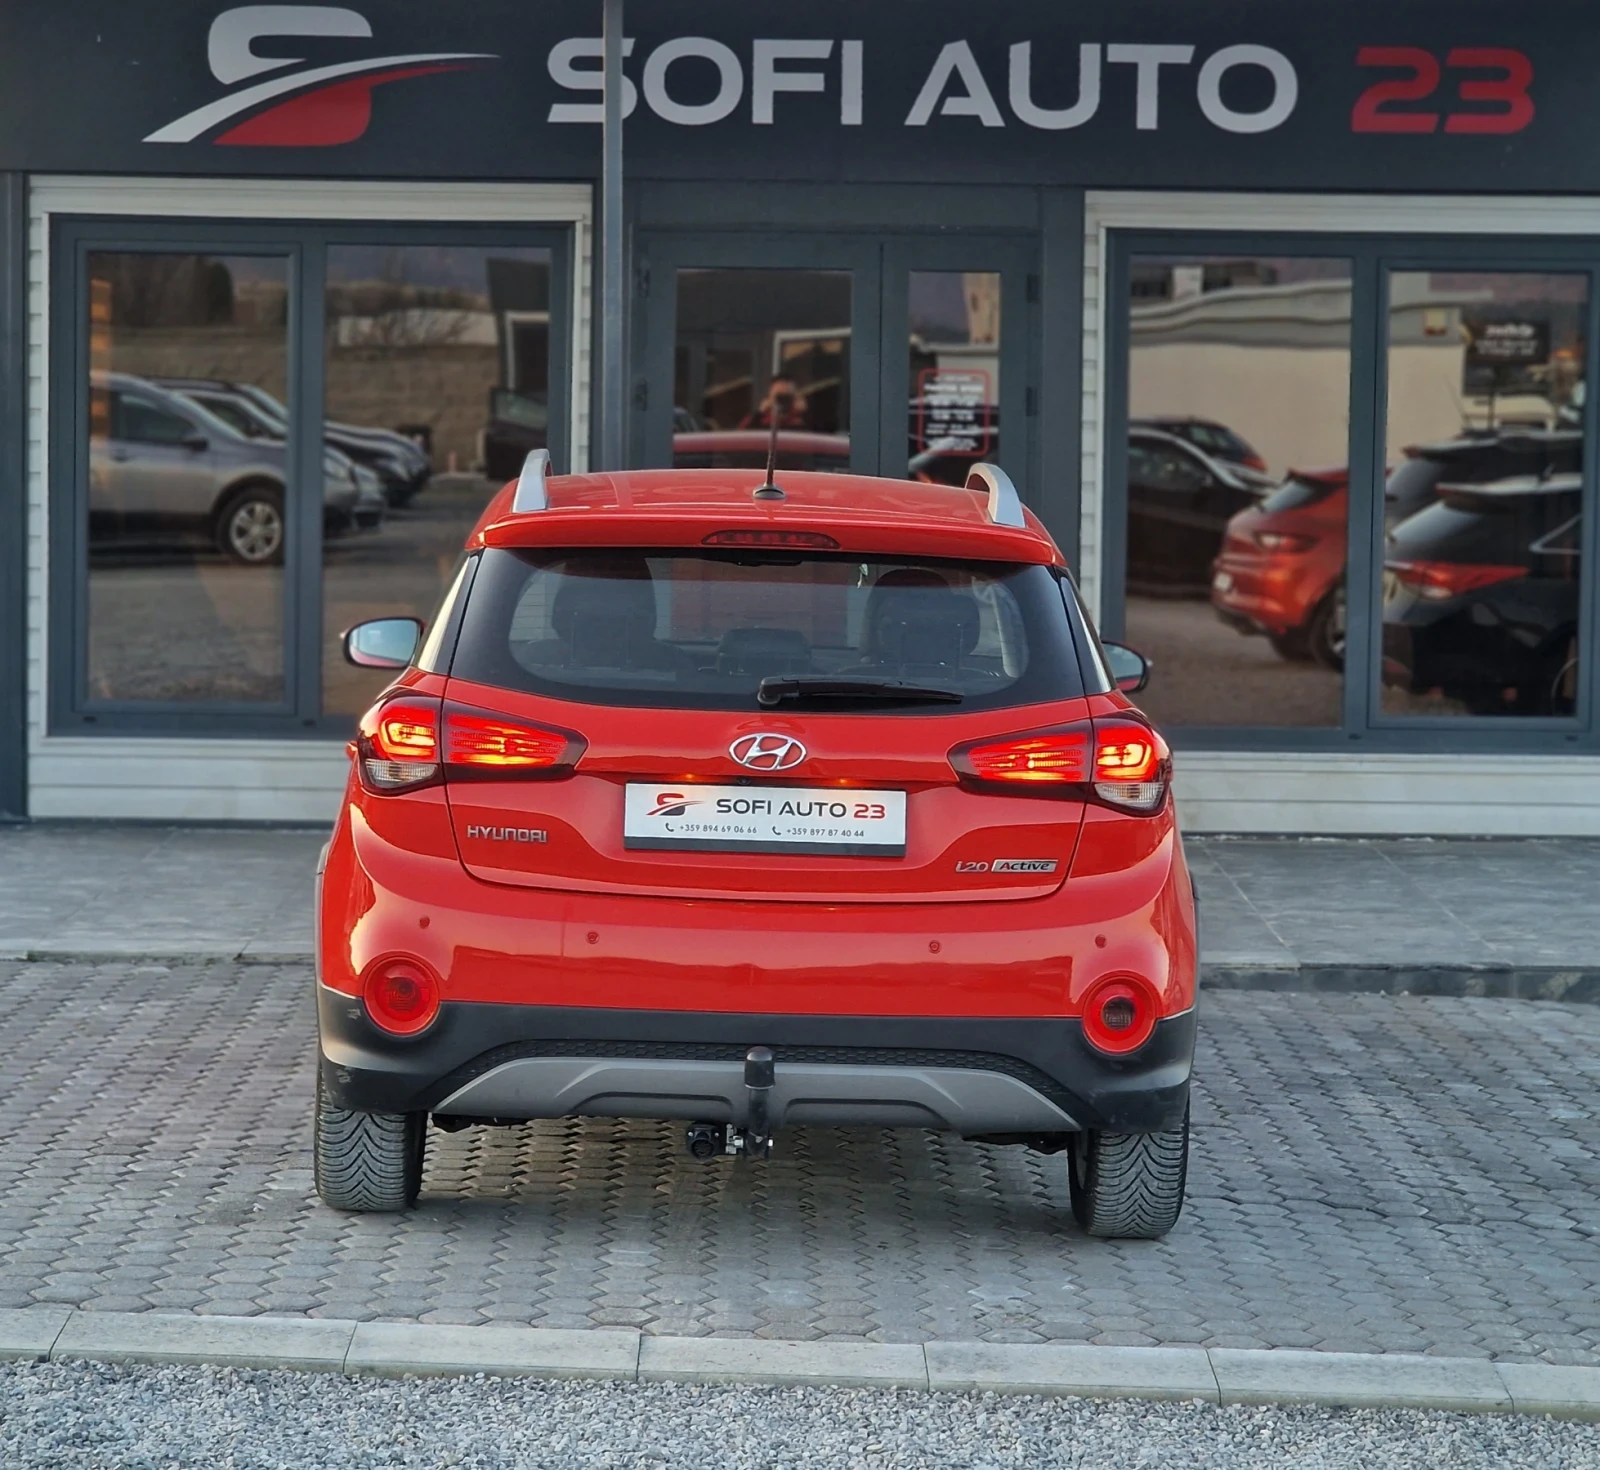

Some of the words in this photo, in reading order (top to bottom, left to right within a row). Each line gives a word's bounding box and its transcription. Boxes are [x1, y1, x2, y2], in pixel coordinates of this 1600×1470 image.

[547, 36, 863, 125] SOFI
[904, 40, 1299, 133] AUTO
[1351, 47, 1535, 134] 23
[716, 798, 772, 815] SOFI
[778, 800, 847, 818] AUTO
[853, 803, 886, 819] 23
[467, 825, 547, 843] HYUNDAI
[680, 824, 701, 832] +359
[702, 824, 719, 833] 894
[721, 825, 732, 833] 69
[733, 825, 745, 834] 06
[747, 826, 758, 834] 66
[786, 827, 807, 836] +359
[809, 828, 826, 837] 897
[827, 829, 839, 837] 87
[841, 829, 852, 838] 40
[854, 830, 865, 838] 44
[955, 861, 989, 873] i20
[1000, 862, 1050, 871] Active
